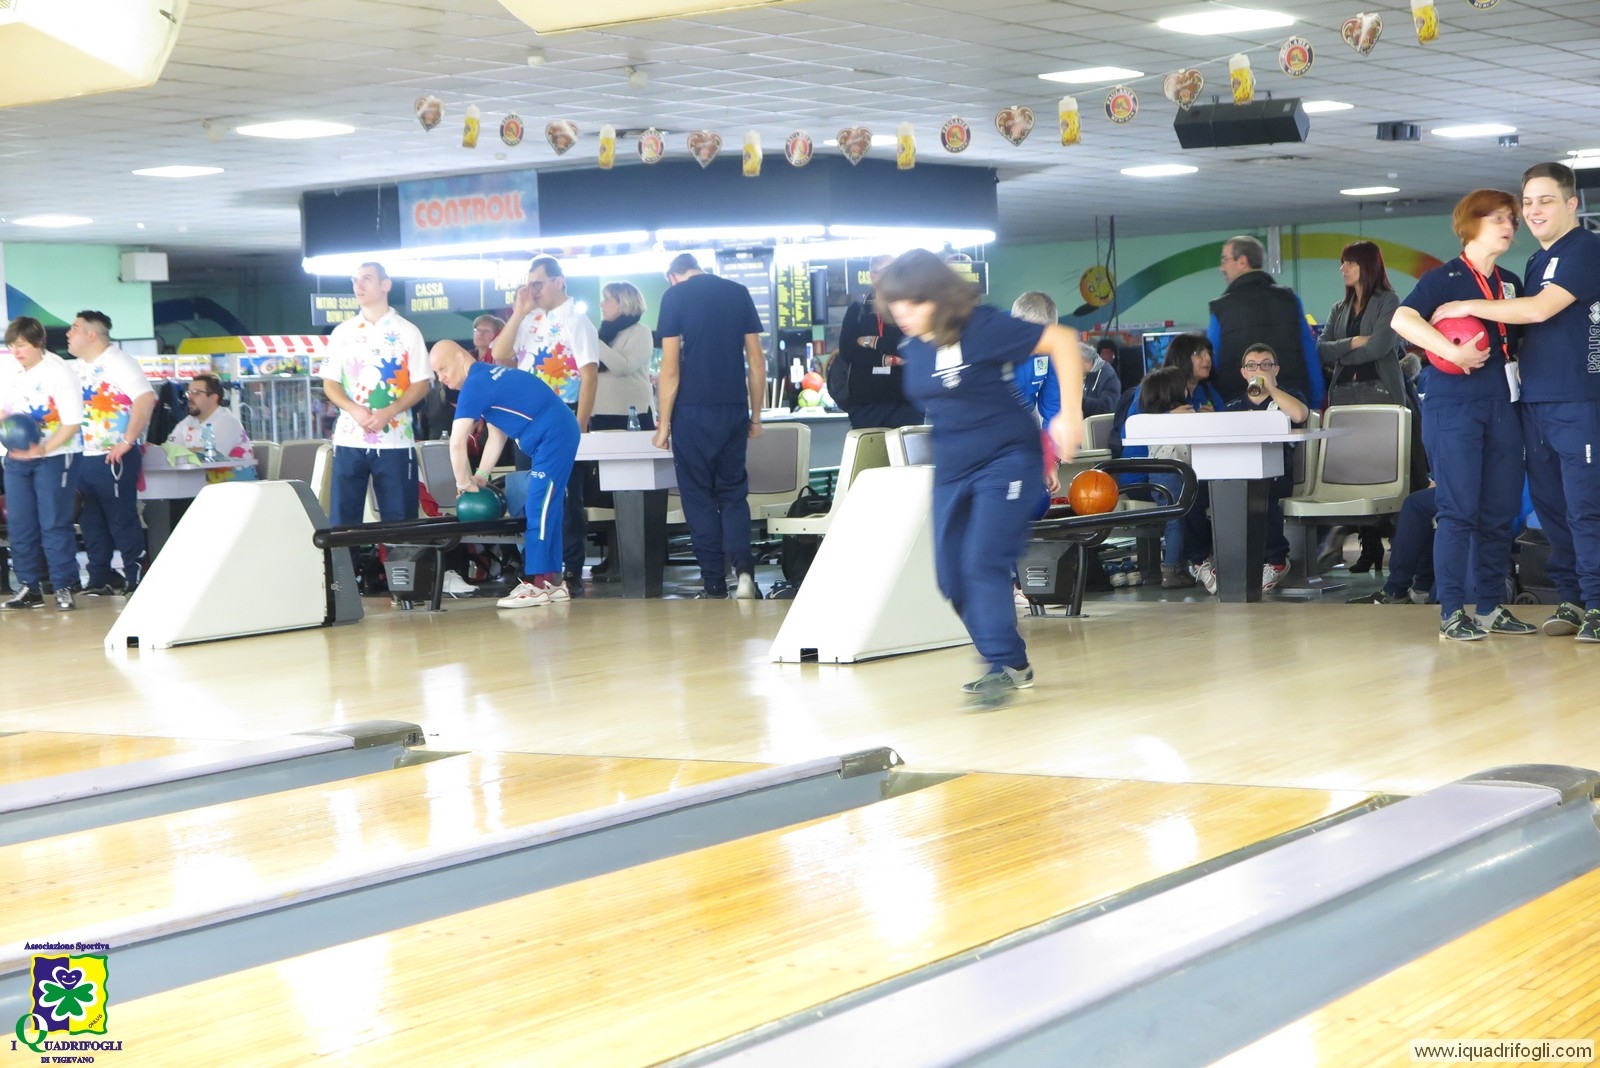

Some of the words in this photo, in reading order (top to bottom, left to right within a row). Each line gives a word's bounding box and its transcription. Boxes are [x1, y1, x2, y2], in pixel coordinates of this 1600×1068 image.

[413, 192, 525, 229] CONTROLL
[415, 282, 444, 297] CASSA
[411, 297, 449, 312] BOWLING
